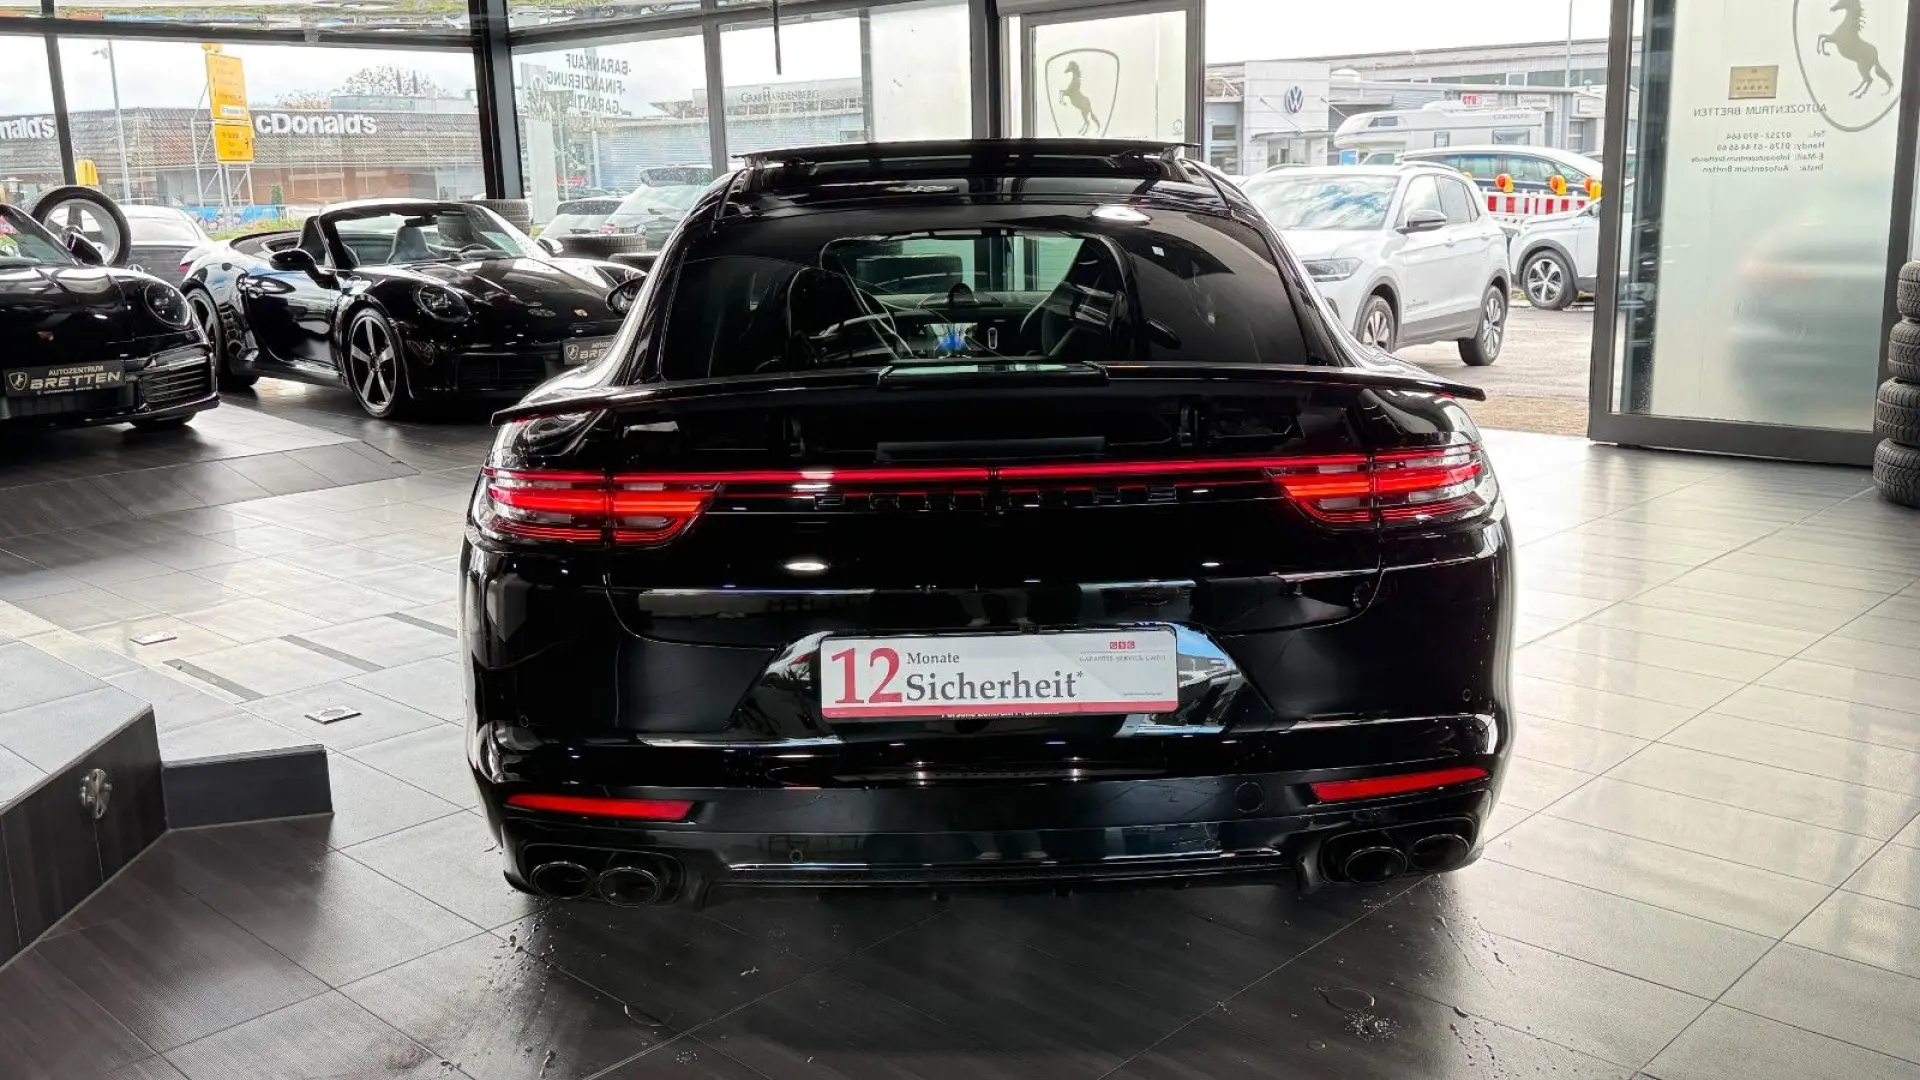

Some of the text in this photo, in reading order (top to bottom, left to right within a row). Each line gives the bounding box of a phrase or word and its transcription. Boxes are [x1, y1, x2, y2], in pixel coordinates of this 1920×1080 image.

[255, 113, 377, 135] cDonald's
[30, 371, 121, 390] BRETTEN
[906, 652, 960, 665] Monate
[831, 647, 903, 704] 12
